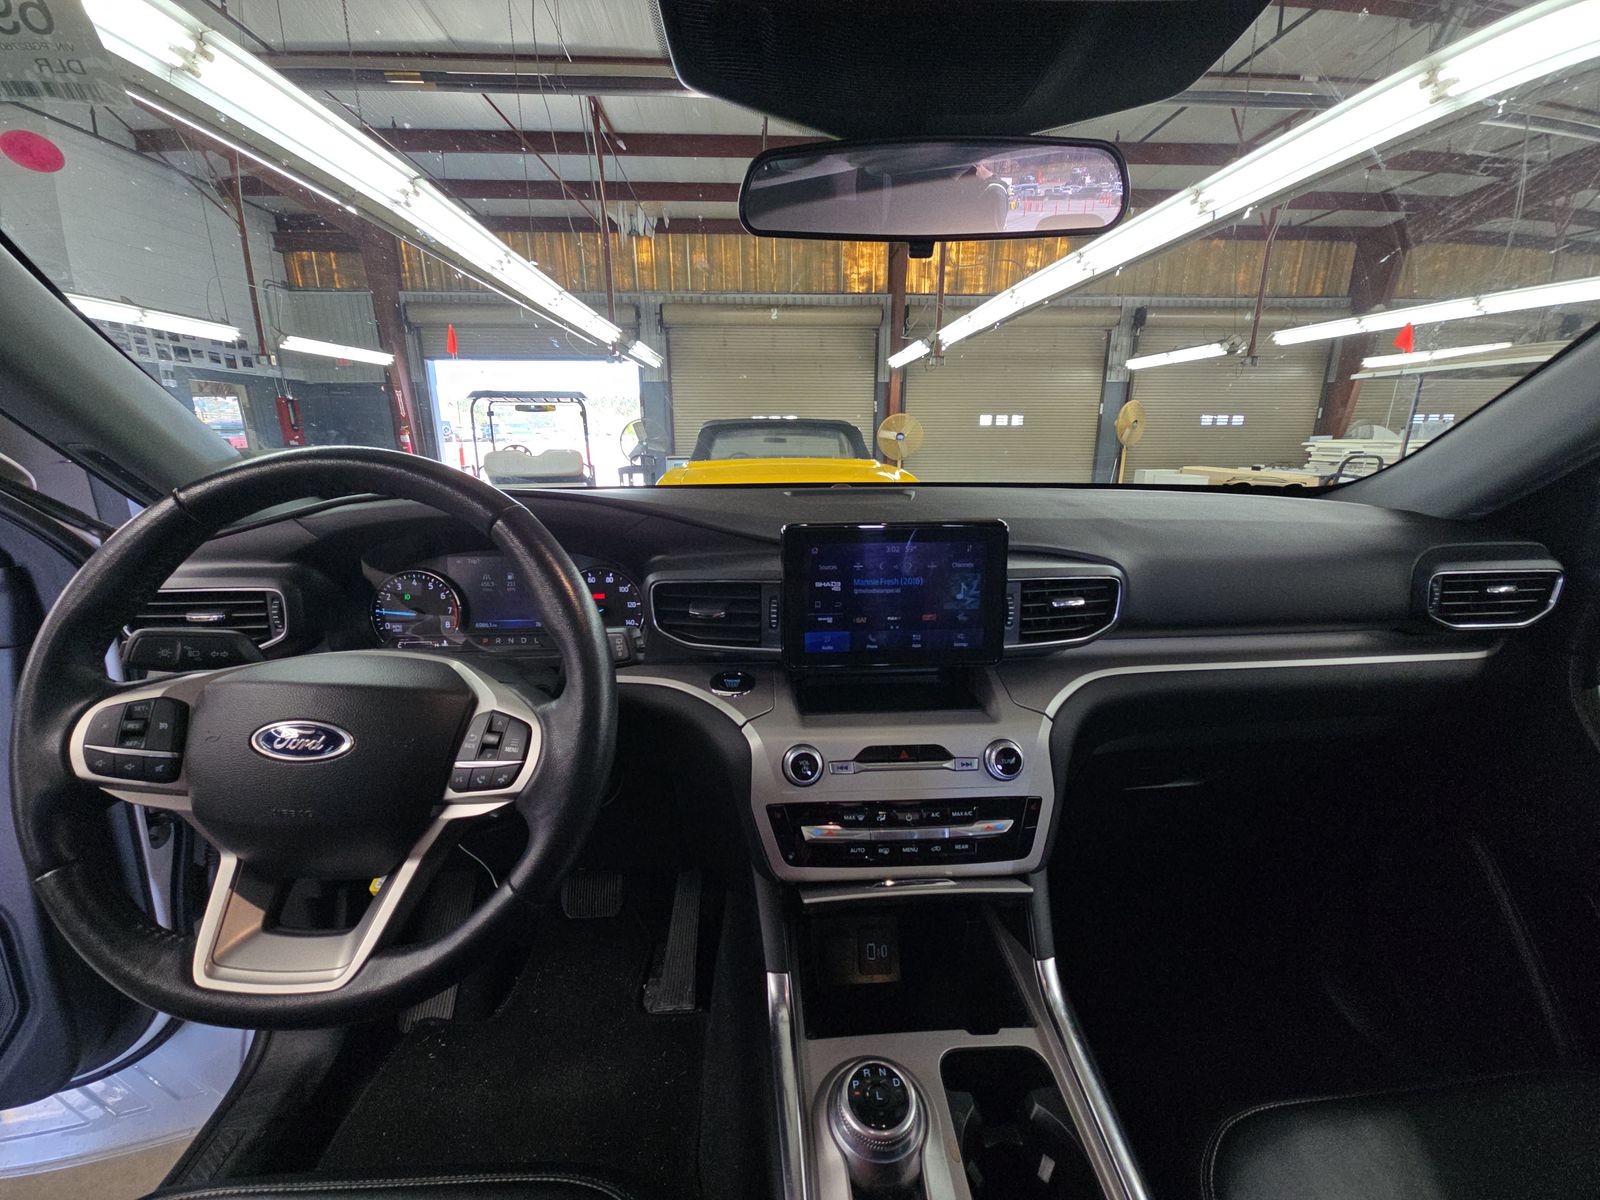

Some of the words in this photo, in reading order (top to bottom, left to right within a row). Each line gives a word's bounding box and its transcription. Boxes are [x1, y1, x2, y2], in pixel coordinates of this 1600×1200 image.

[863, 1068, 871, 1077] R
[879, 1068, 887, 1076] N
[852, 1080, 860, 1089] P
[893, 1078, 900, 1087] D
[876, 1091, 883, 1100] L
